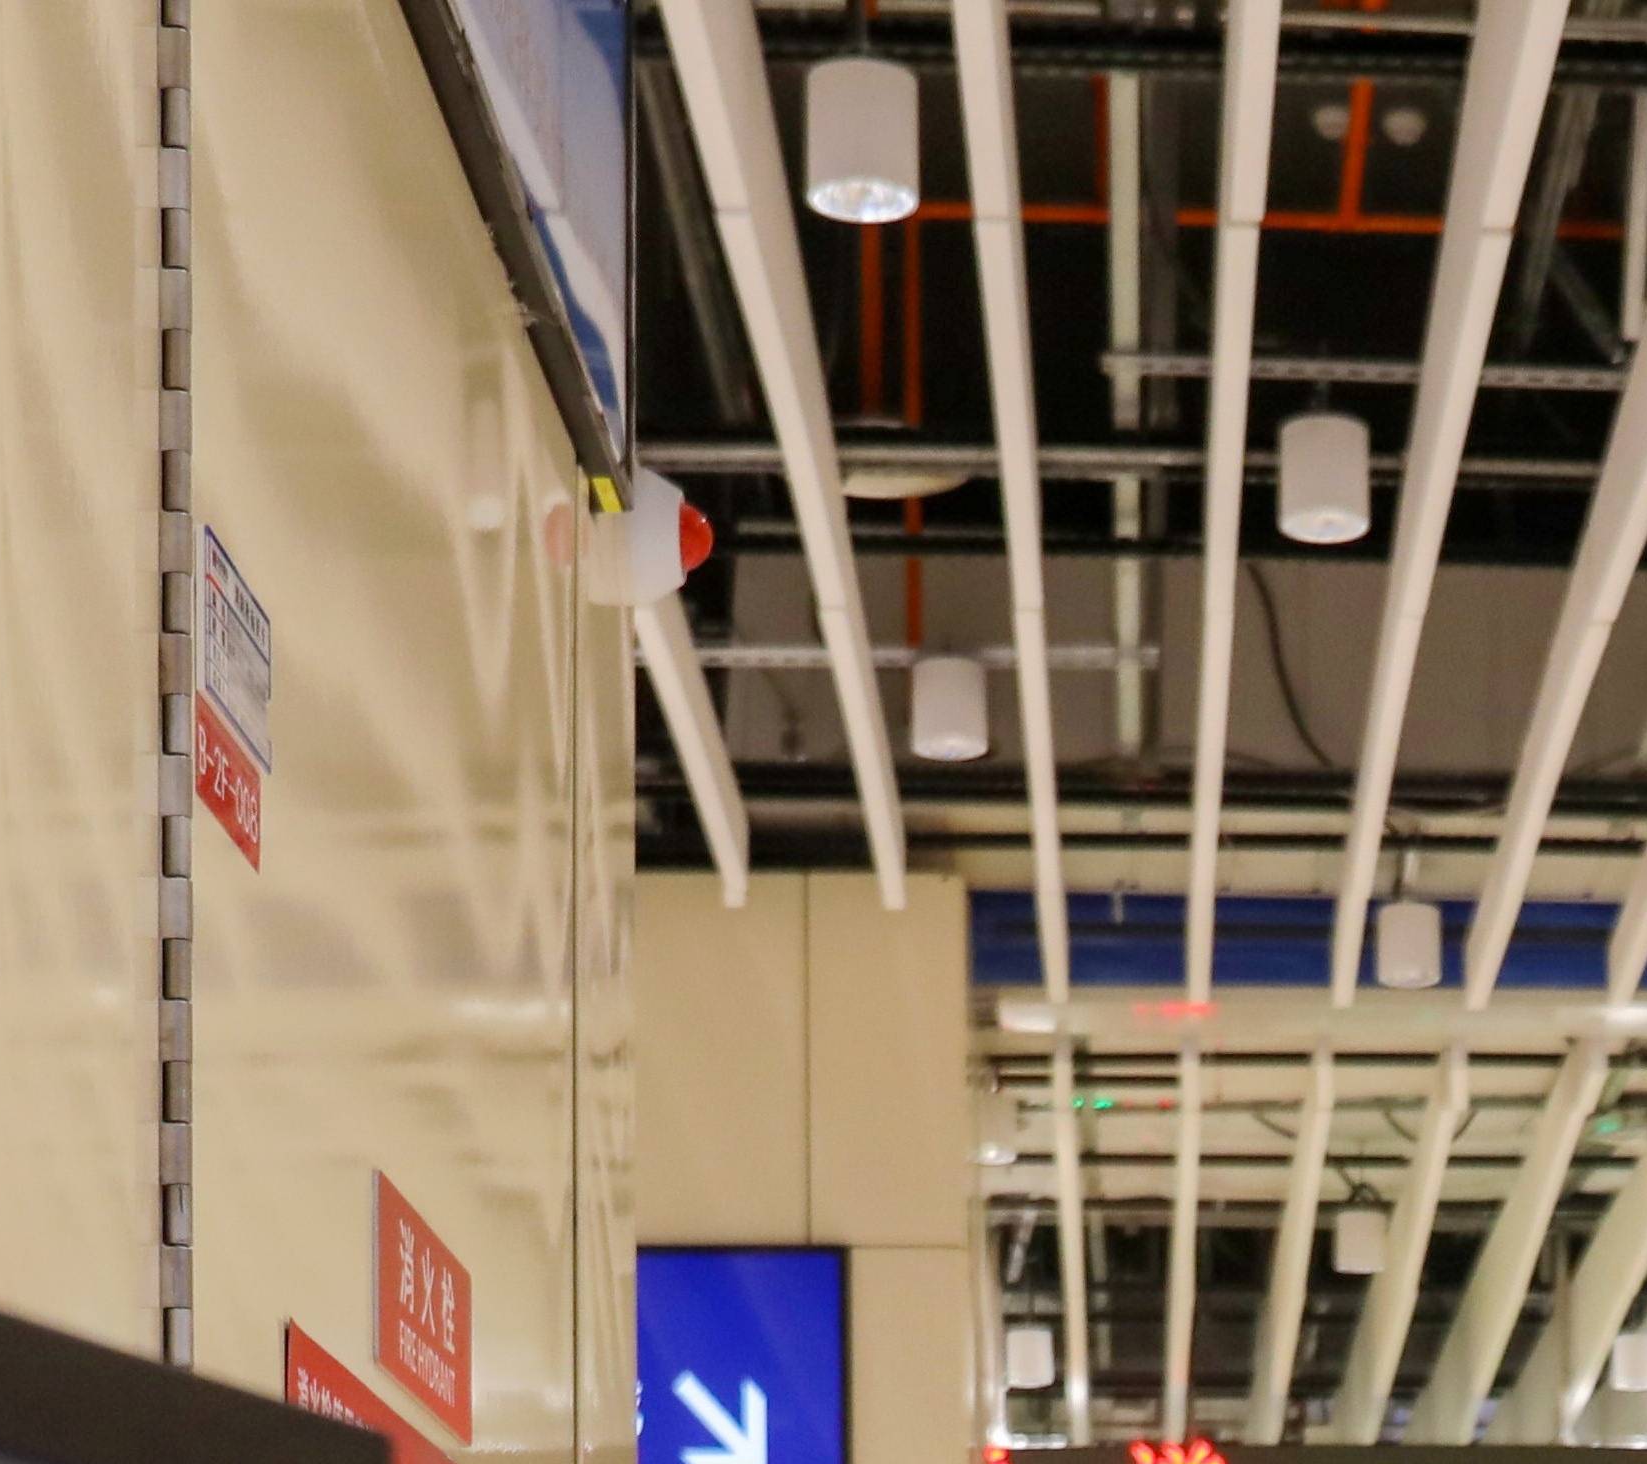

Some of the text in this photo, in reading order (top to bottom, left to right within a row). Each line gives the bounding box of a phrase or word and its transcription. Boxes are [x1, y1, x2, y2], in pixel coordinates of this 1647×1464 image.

[198, 723, 259, 843] B-2F-008
[399, 1218, 456, 1355] 消火栓
